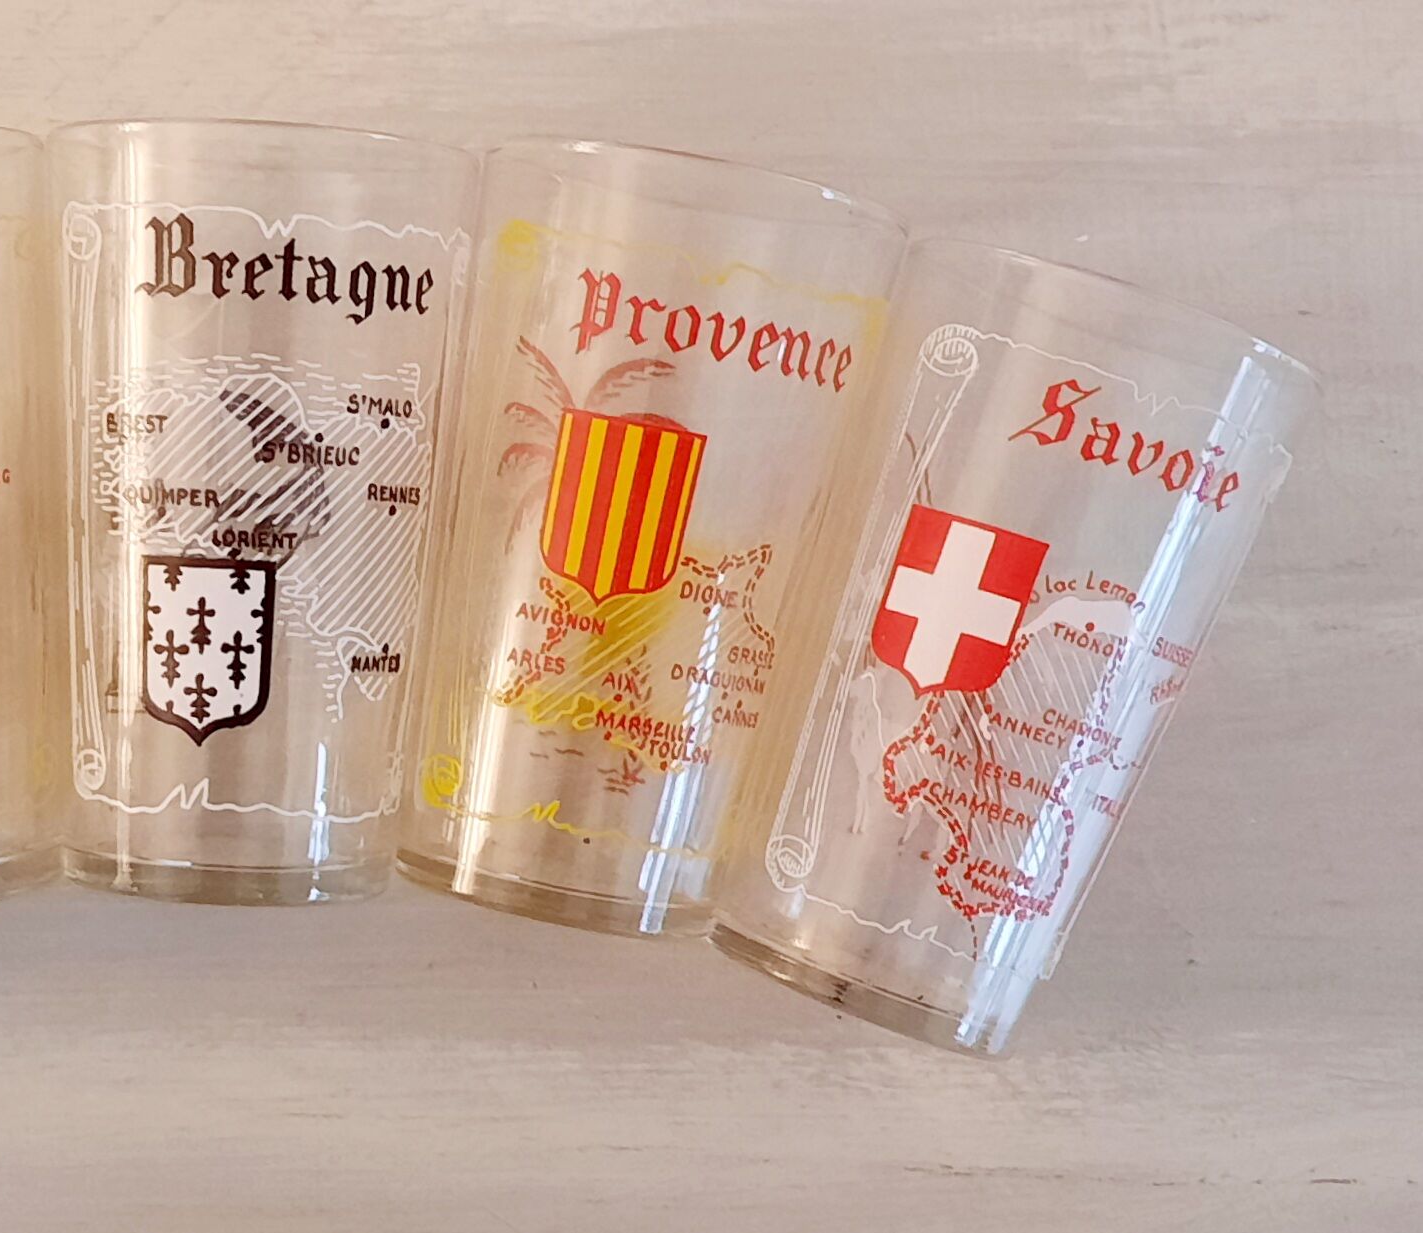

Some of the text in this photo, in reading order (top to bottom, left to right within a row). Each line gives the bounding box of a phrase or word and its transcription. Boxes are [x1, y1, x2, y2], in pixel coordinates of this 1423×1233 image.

[135, 213, 434, 324] Bretagne
[572, 268, 852, 392] Provence
[1008, 379, 1239, 512] Savoie
[123, 482, 221, 508] QUIMPER
[367, 483, 420, 505] RENNES
[212, 528, 298, 549] LORIENT
[1045, 574, 1076, 594] lac
[516, 602, 606, 635] AVIGNON
[507, 648, 565, 675] ARLES
[602, 671, 638, 695] AIX
[595, 709, 695, 743] MARSEILLE
[990, 712, 1067, 749] ANNECY
[650, 740, 712, 765] TOULON
[930, 782, 1037, 829] CHAMBERY
